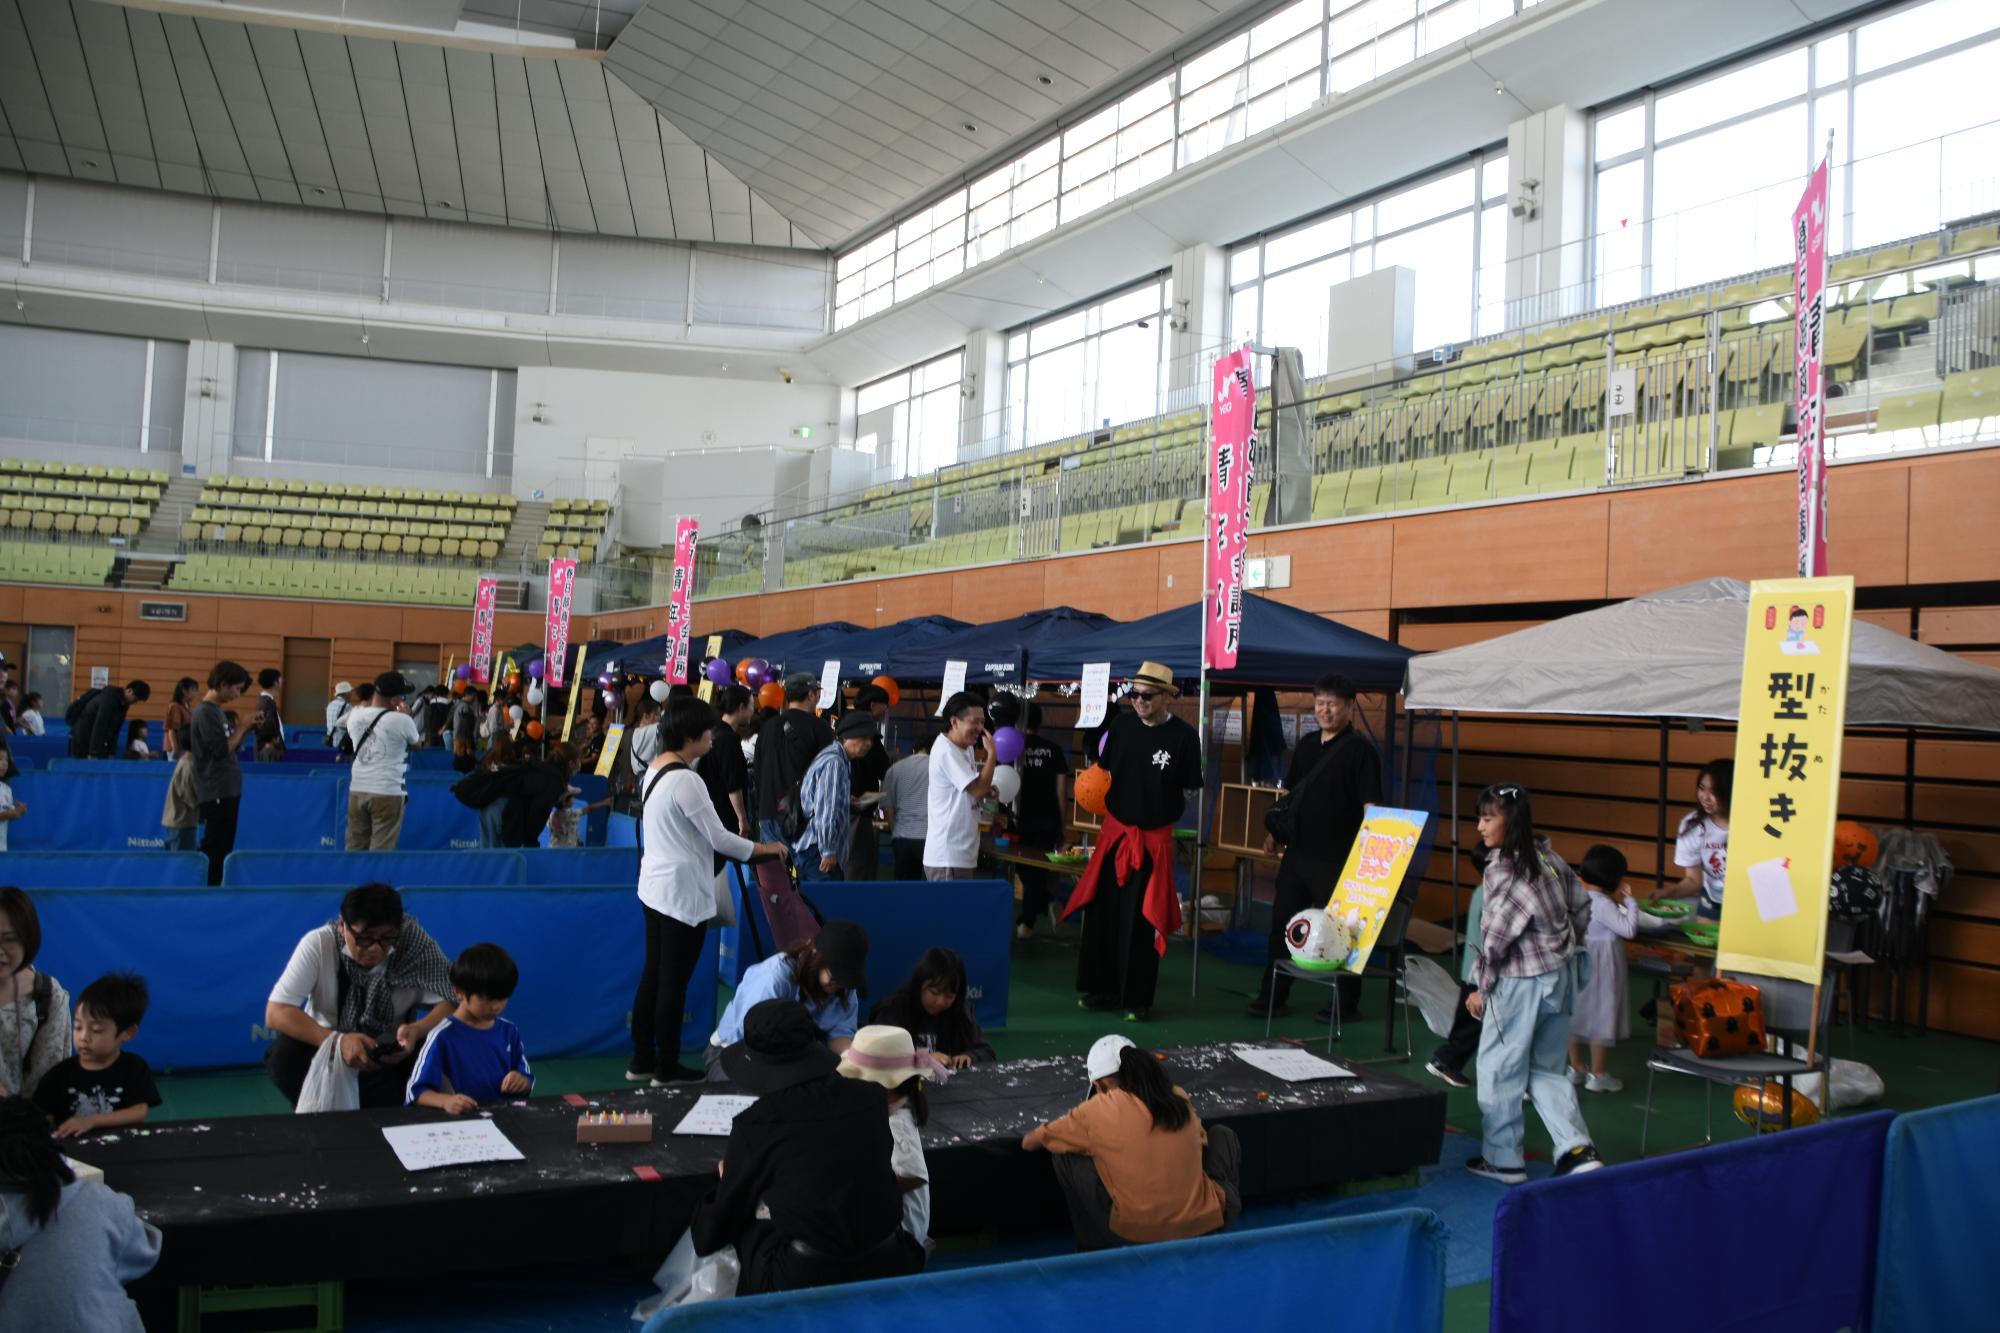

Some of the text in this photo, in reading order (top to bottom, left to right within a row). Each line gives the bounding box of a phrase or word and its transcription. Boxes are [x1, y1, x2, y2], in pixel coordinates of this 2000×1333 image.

[1818, 685, 1831, 715] かた
[1760, 671, 1815, 839] 型抜き
[449, 838, 480, 848] Nittak
